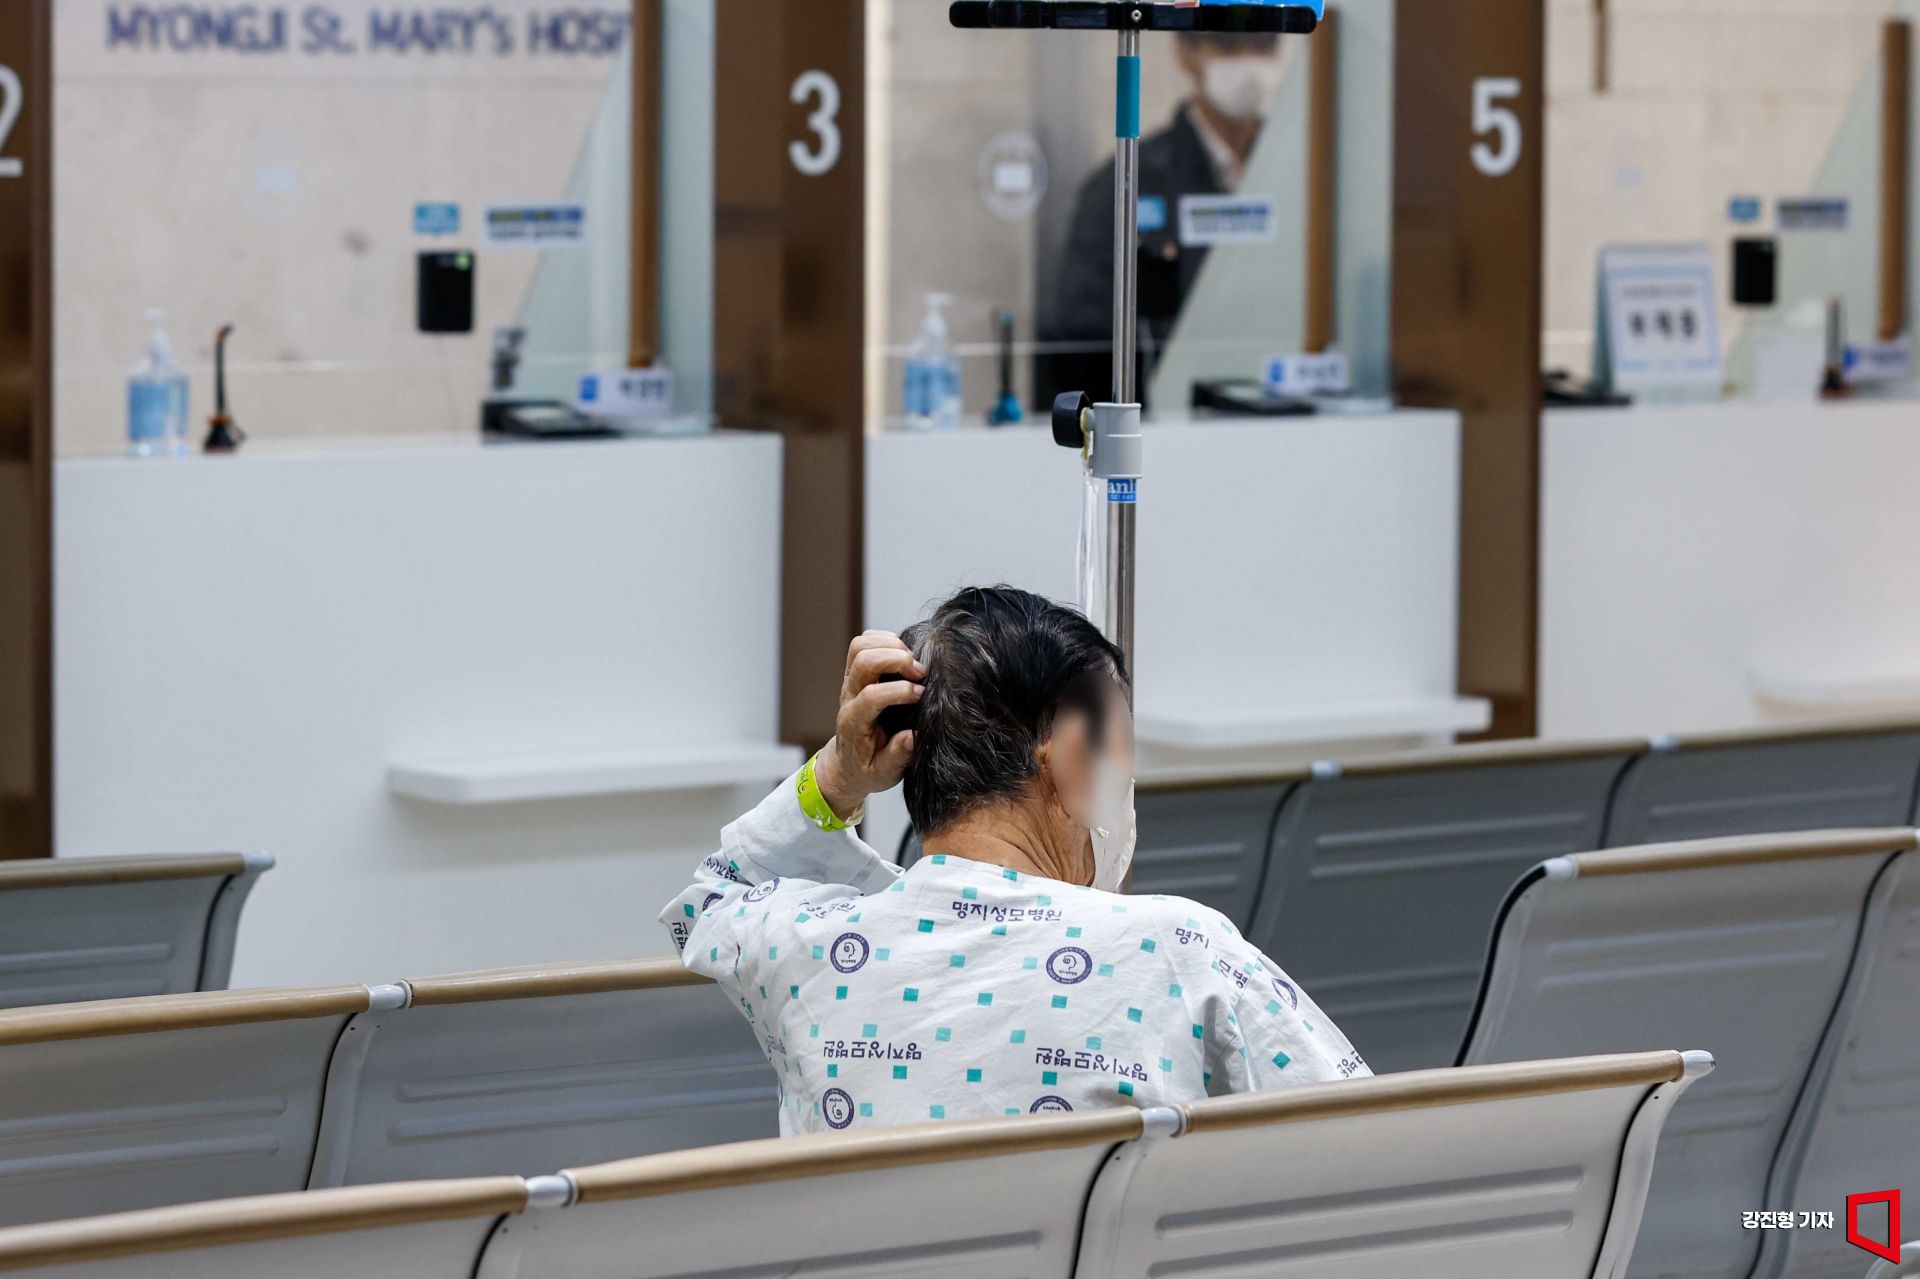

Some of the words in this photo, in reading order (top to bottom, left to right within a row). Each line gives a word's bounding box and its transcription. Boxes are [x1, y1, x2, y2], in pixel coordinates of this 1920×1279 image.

[106, 7, 287, 54] MYONGJI
[788, 69, 841, 177] 3
[1470, 76, 1522, 177] 5
[952, 901, 1062, 922] 명지성모병원
[823, 1040, 922, 1060] 명지성모병원
[1035, 1047, 1148, 1082] 명지성모병원
